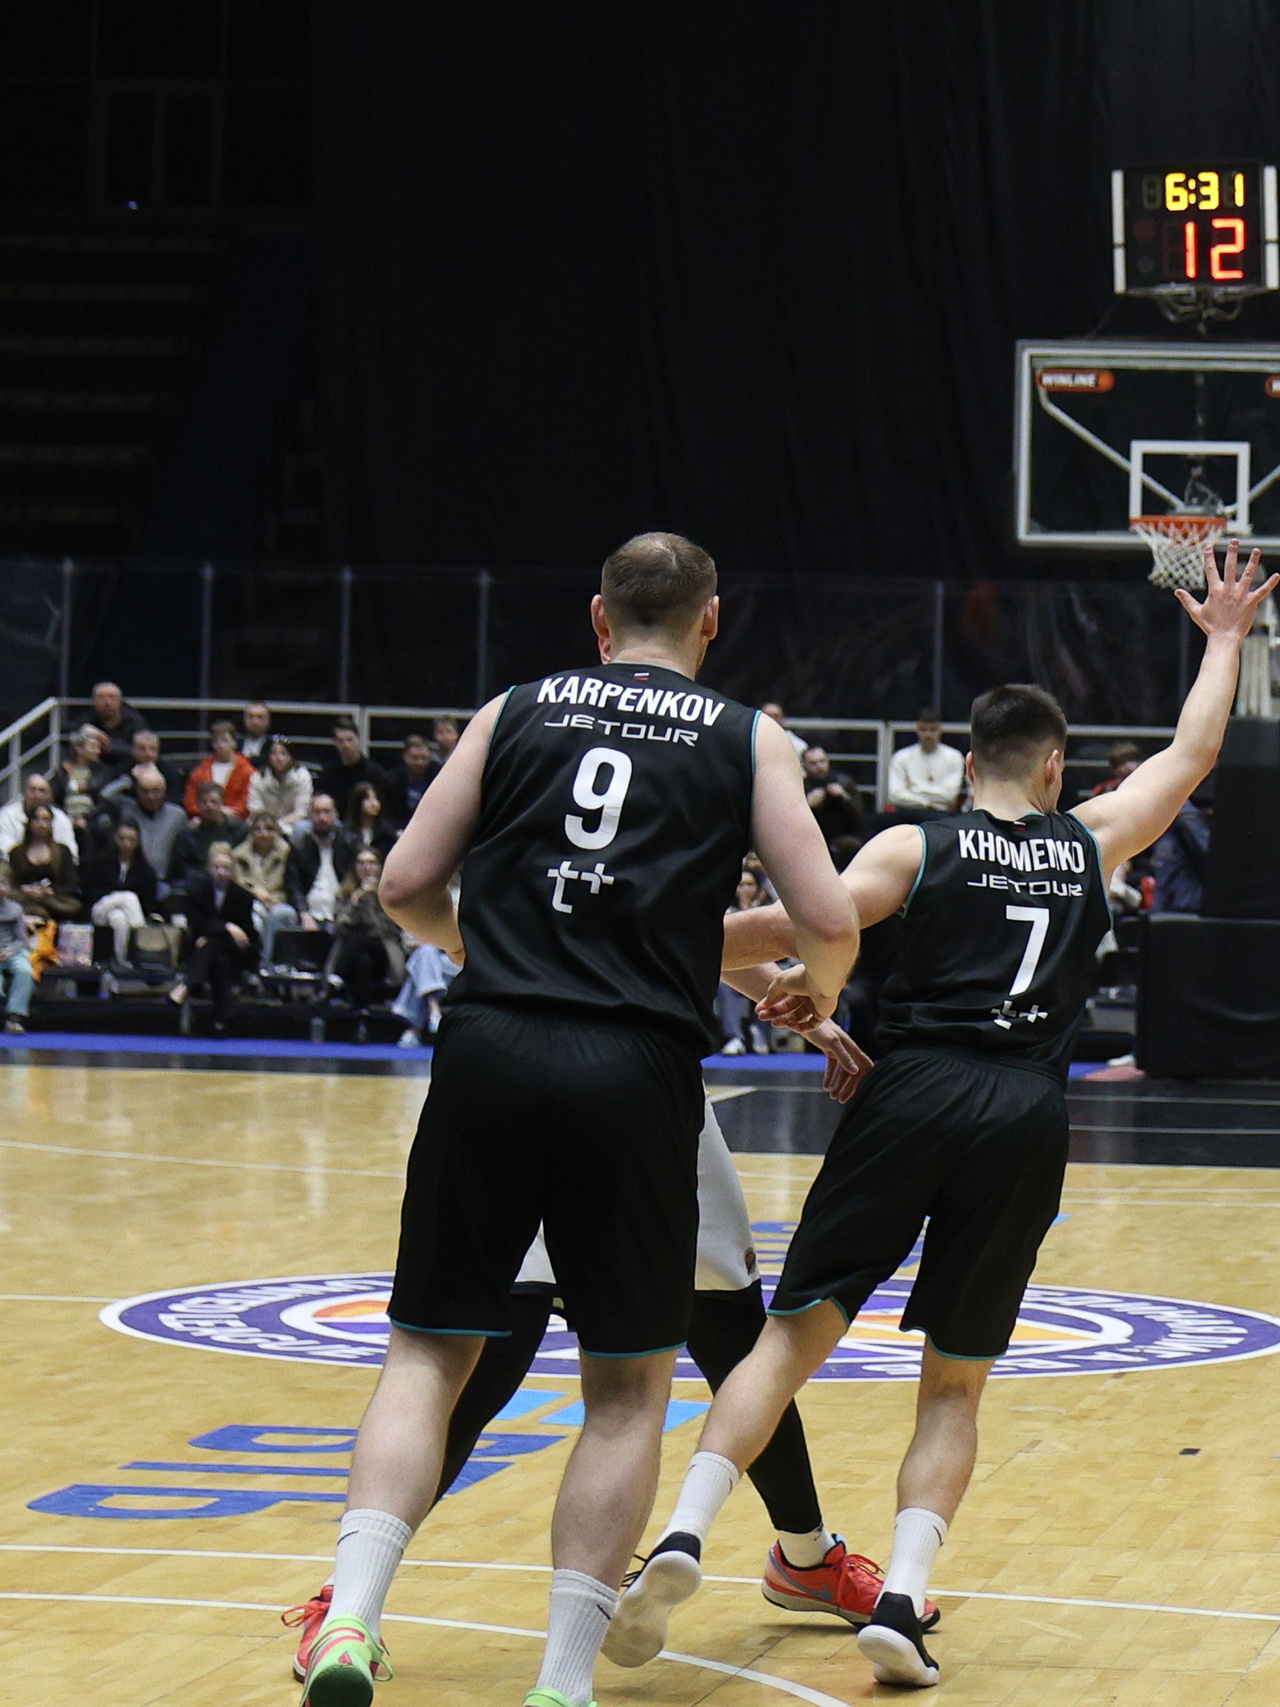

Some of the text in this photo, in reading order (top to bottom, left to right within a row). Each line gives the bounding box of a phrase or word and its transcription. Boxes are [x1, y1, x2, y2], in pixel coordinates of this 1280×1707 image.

[1165, 171, 1244, 211] 6:31
[1184, 218, 1244, 279] 12
[1041, 372, 1097, 388] WINLINE
[537, 675, 726, 727] KARPENKOV
[544, 713, 699, 748] JETOUR
[564, 746, 633, 850] 9
[958, 829, 1086, 875] KHOMENKO
[967, 873, 1084, 897] JETOUR
[1005, 904, 1050, 996] 7
